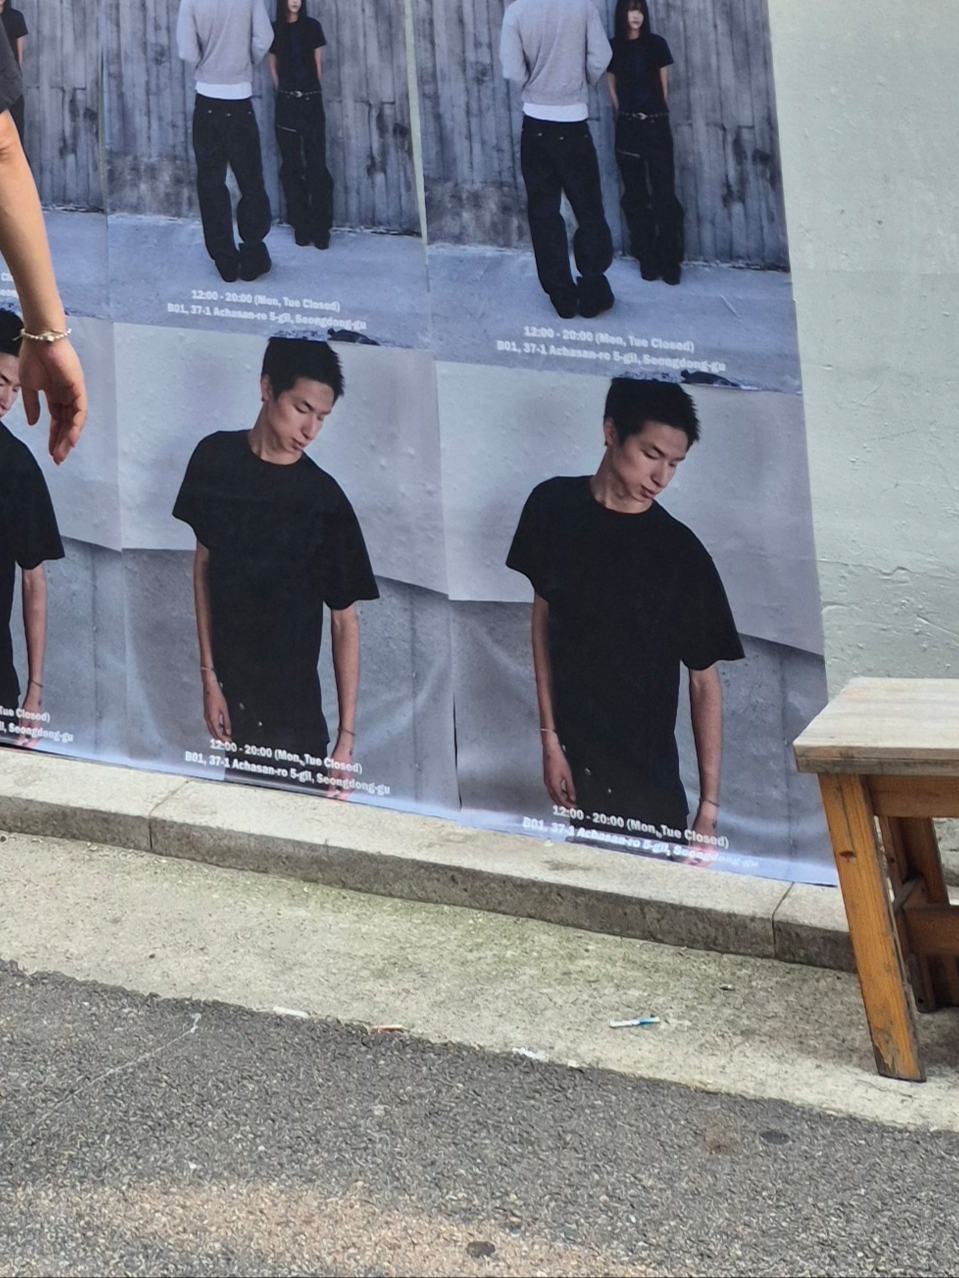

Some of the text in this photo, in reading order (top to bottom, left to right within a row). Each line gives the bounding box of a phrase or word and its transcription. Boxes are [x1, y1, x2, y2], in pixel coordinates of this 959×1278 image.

[524, 326, 554, 340] 12:00
[562, 329, 593, 343] 20:00
[210, 739, 237, 754] 12:00
[244, 744, 272, 760] 20:00
[208, 756, 230, 770] 37-1
[552, 805, 584, 823] 12:00
[592, 812, 624, 830] 20:00
[661, 824, 681, 840] Tue
[684, 829, 729, 849] Closed)
